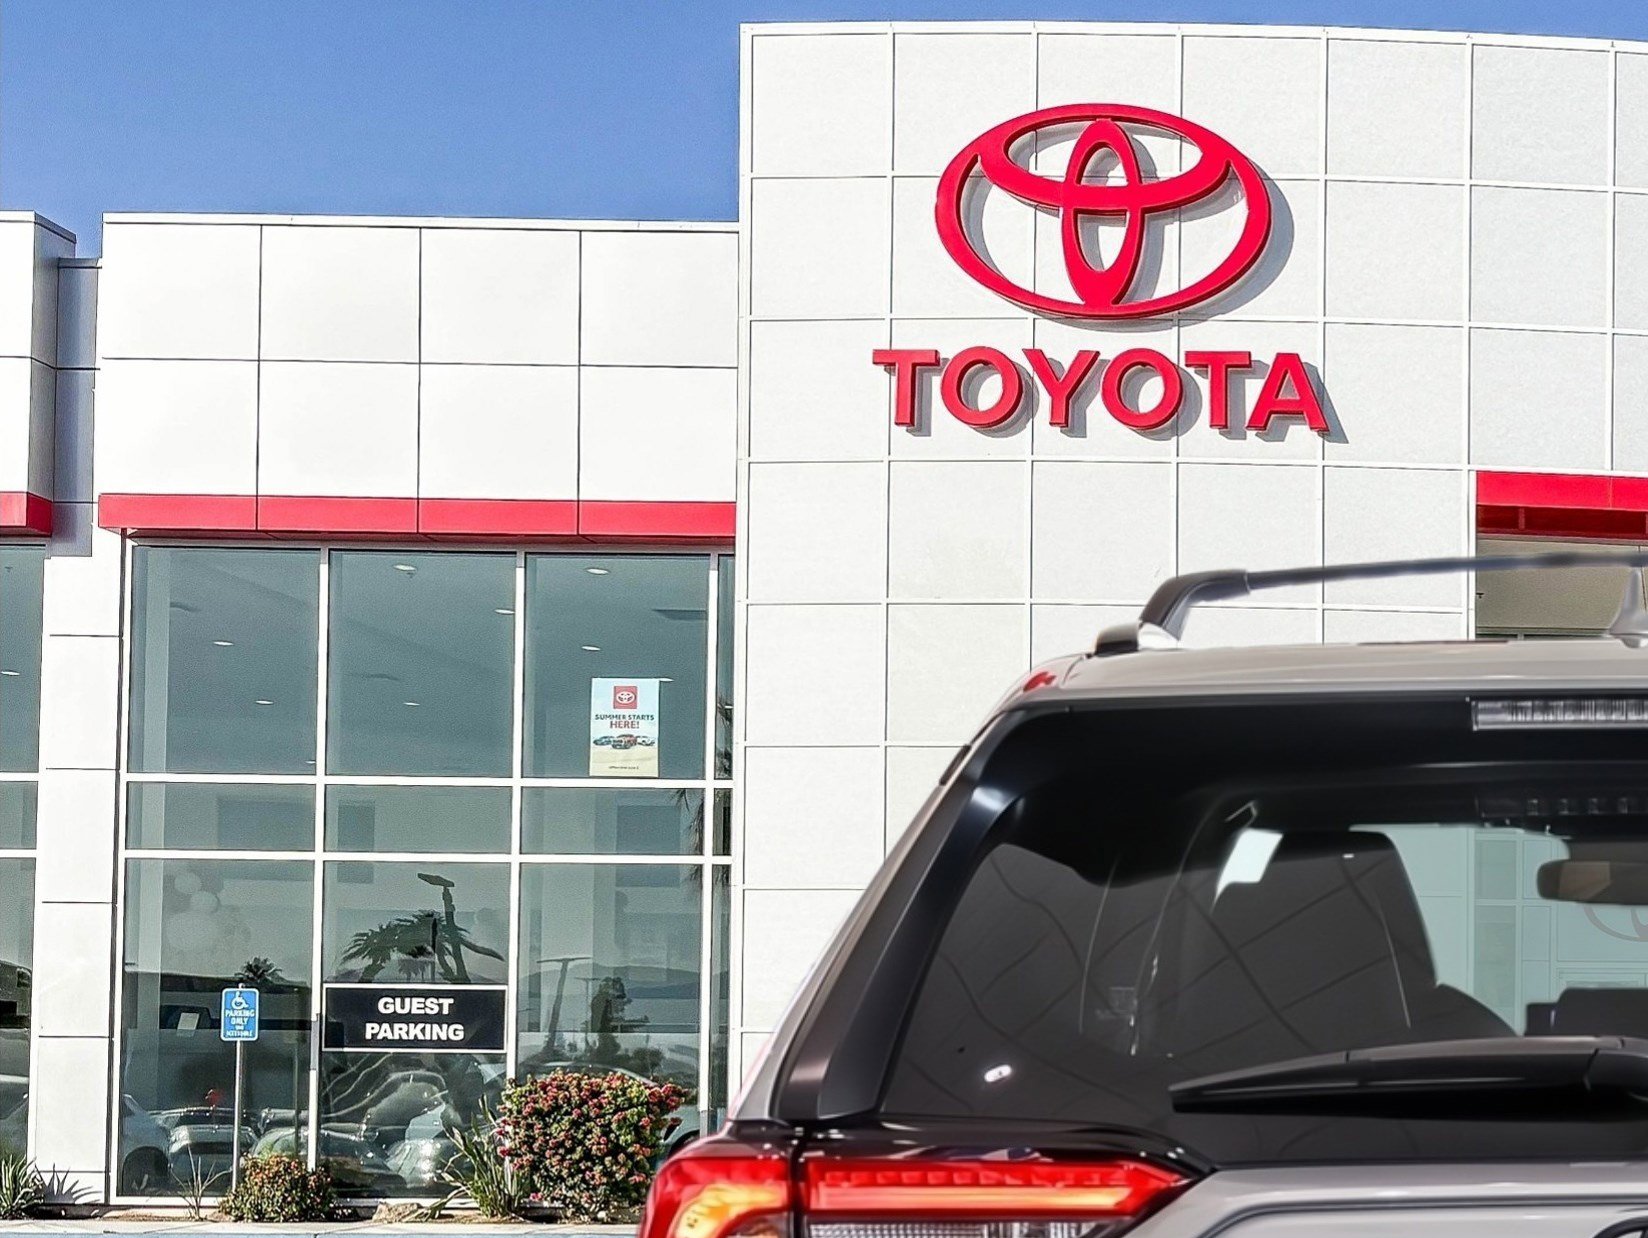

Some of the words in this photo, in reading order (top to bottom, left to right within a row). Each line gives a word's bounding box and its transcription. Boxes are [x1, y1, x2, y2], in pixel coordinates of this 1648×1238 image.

[872, 346, 1330, 432] TOYOTA
[609, 721, 640, 729] HERE!
[377, 997, 454, 1015] GUEST
[365, 1022, 465, 1041] PARKING
